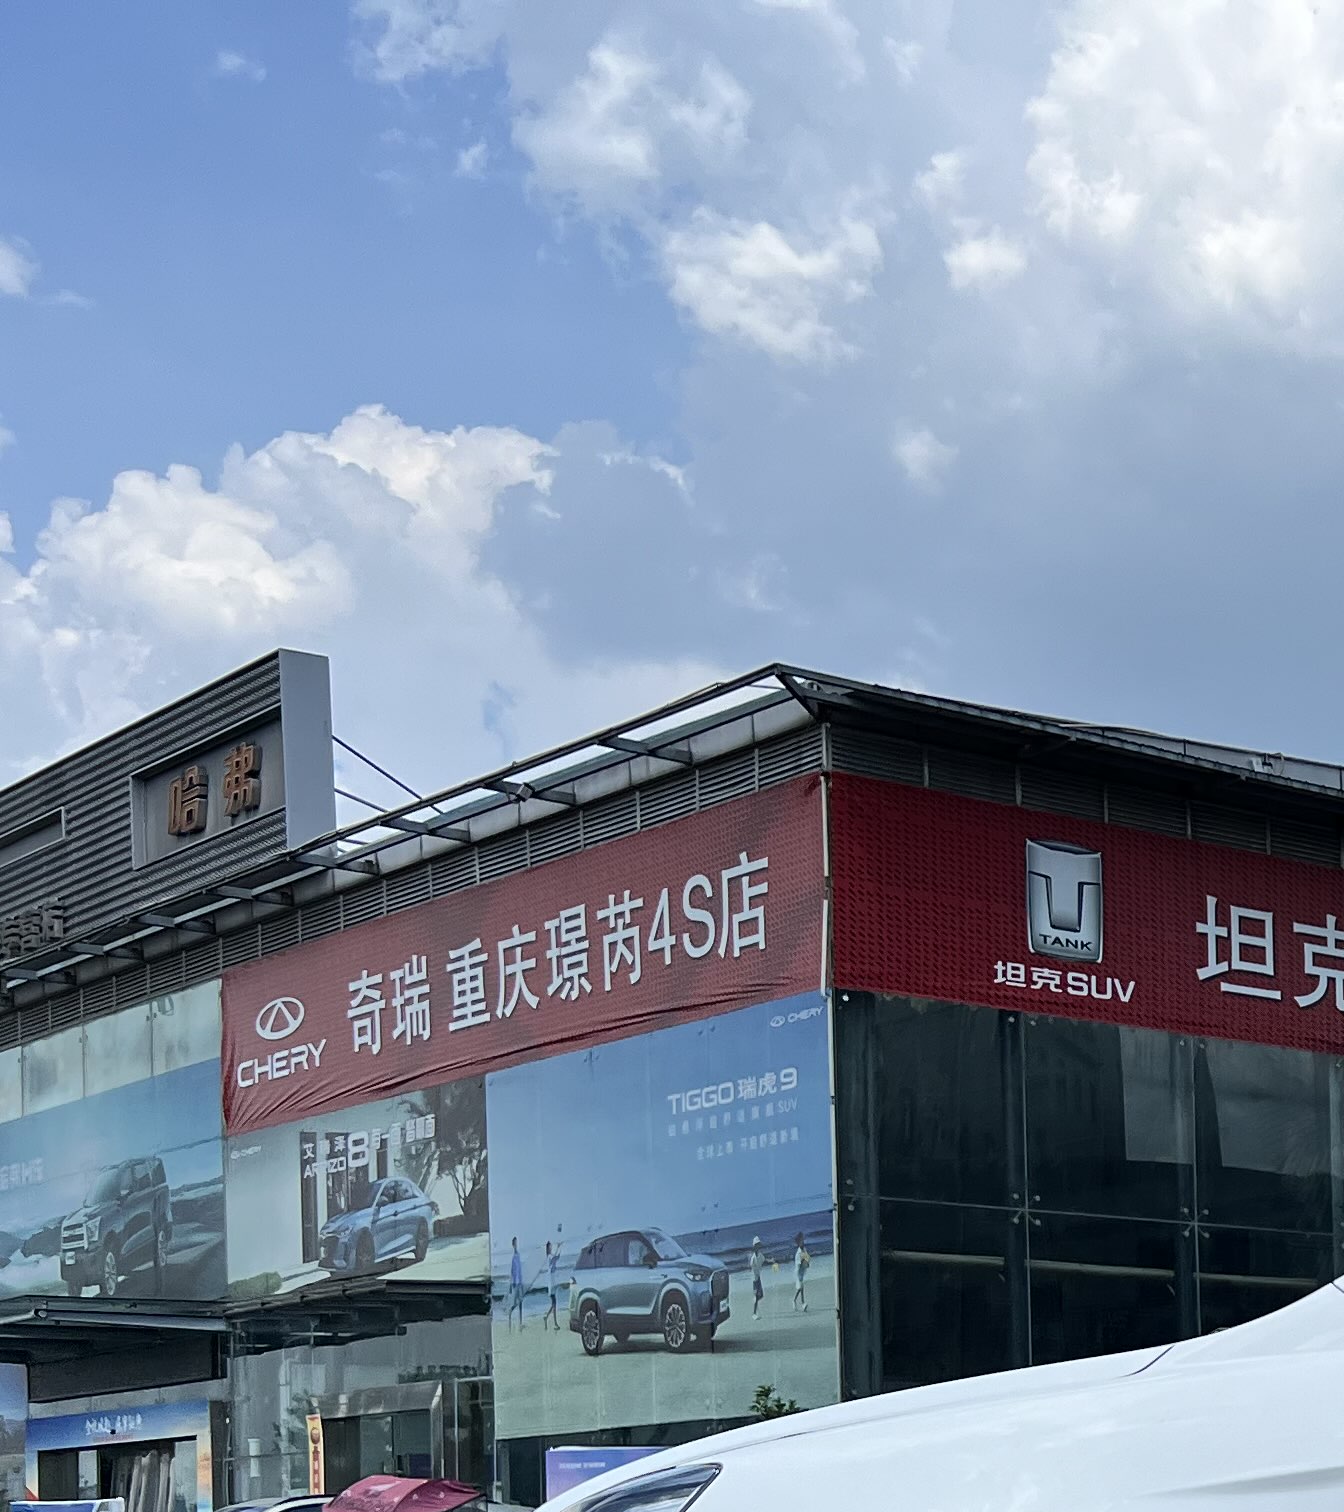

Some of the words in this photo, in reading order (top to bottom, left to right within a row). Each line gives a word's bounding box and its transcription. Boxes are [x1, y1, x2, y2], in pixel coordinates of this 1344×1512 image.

[346, 955, 432, 1056] 奇瑞
[446, 852, 770, 1034] 重庆璟芮4S店
[1038, 933, 1093, 951] TANK
[993, 960, 1136, 1003] 坦克SUV
[787, 1006, 824, 1023] CHERY
[236, 1038, 328, 1089] CHERY
[667, 1081, 735, 1115] TIGGO
[347, 1130, 369, 1168] 8
